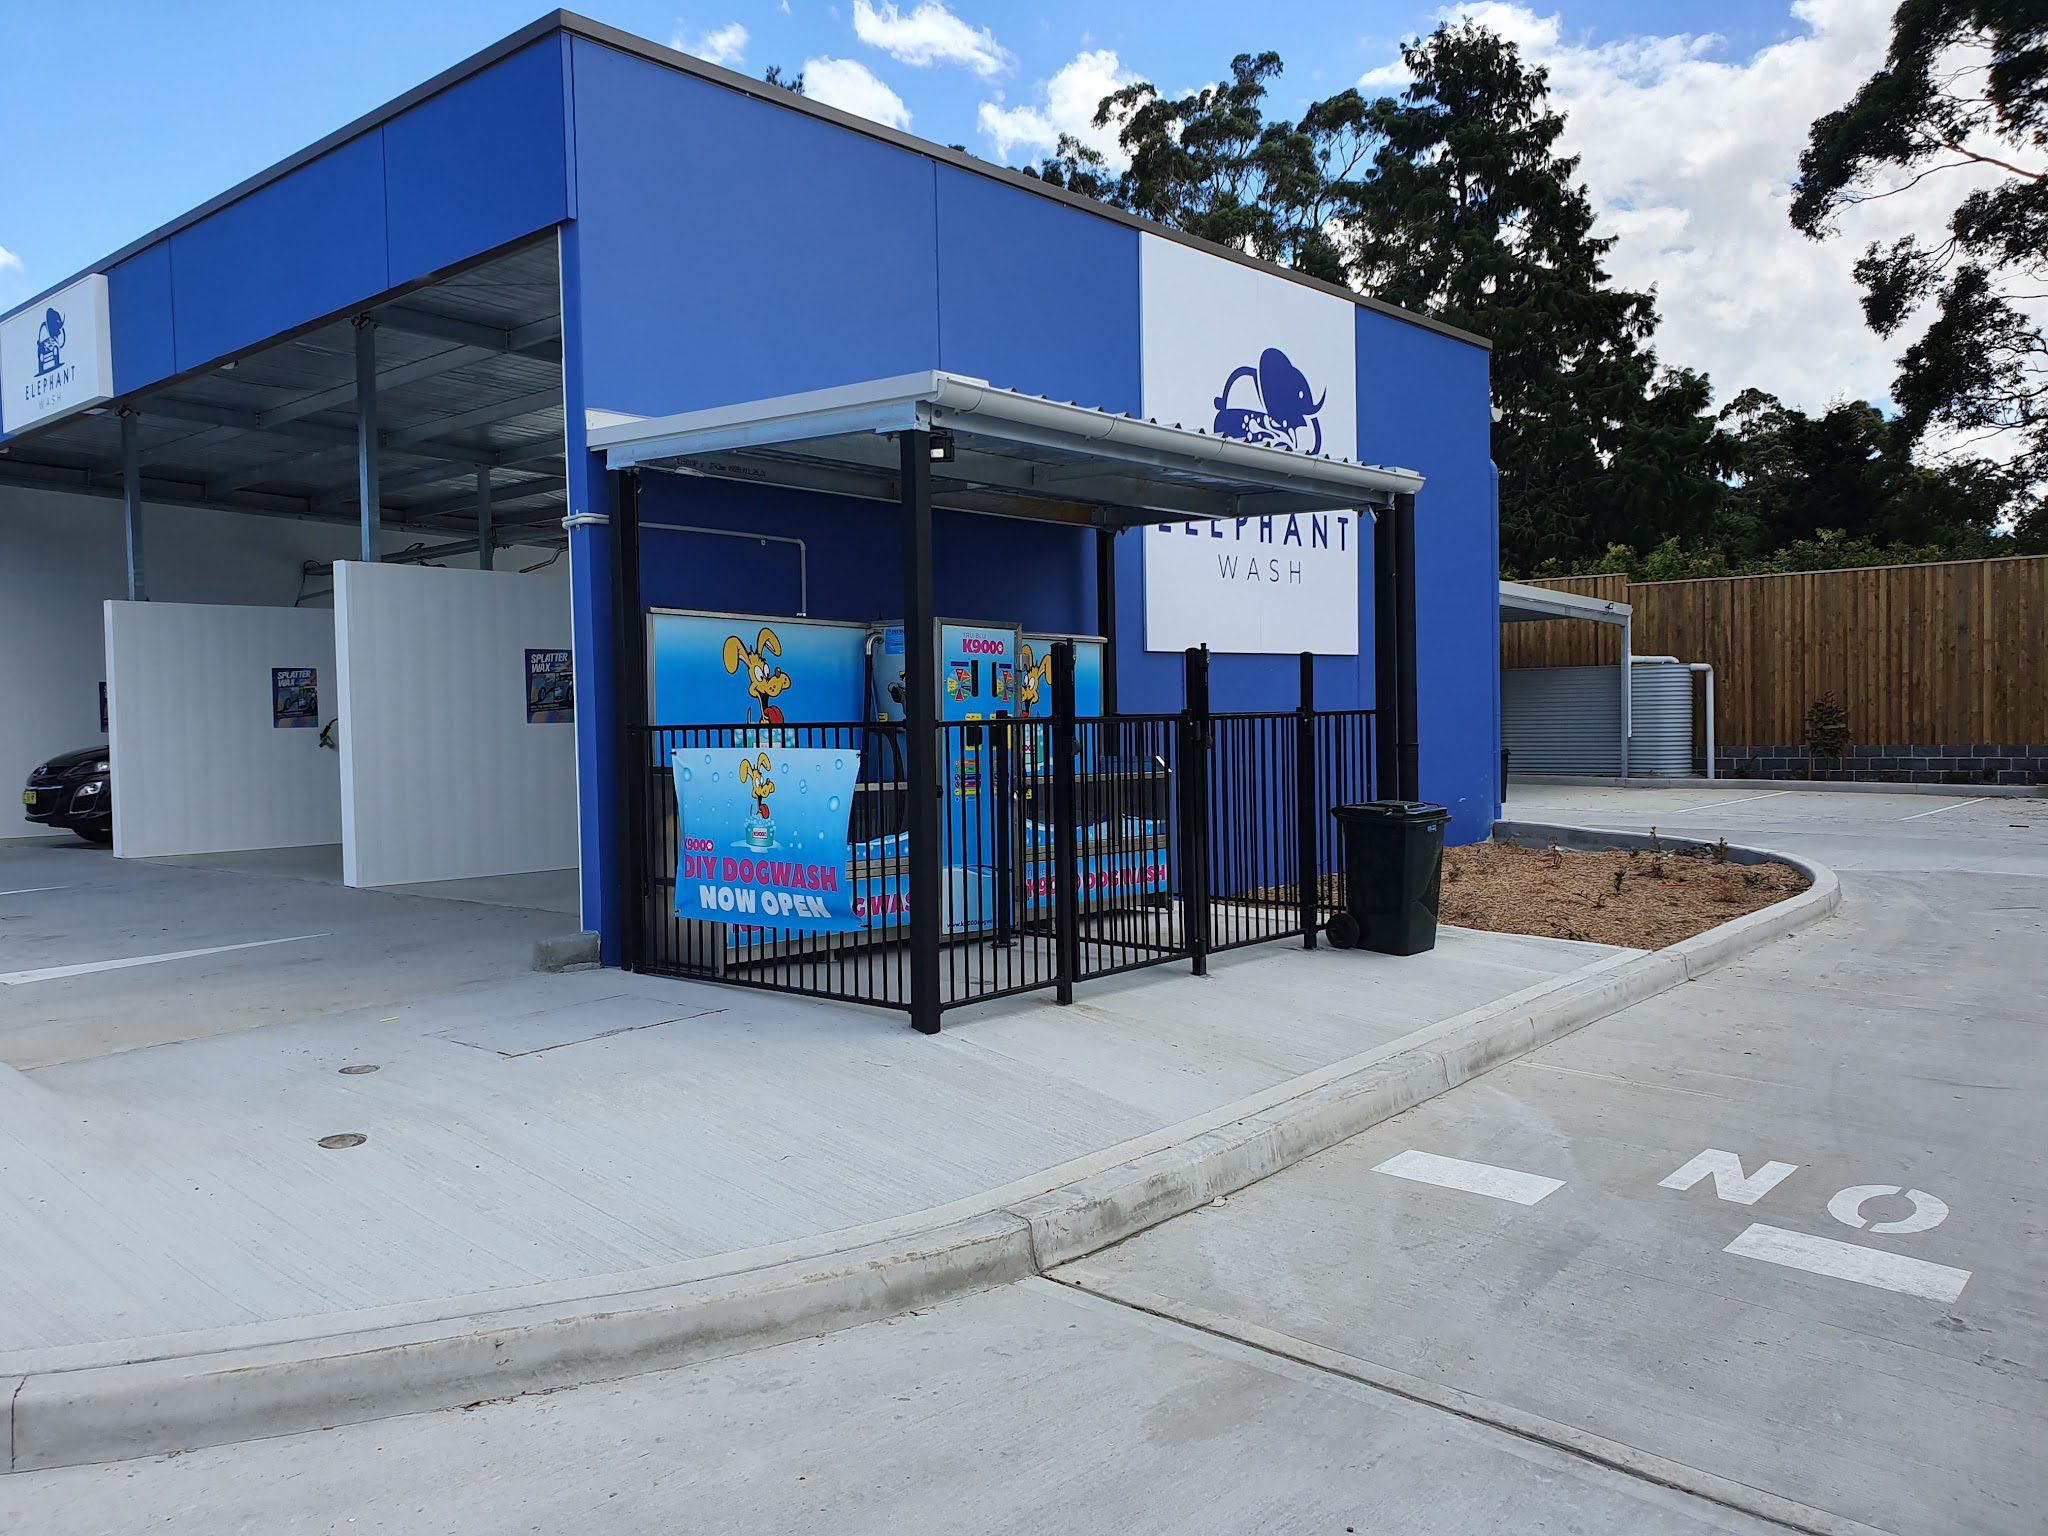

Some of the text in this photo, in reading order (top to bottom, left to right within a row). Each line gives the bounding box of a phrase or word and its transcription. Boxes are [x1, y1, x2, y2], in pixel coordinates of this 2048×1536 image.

[25, 365, 75, 401] ELEPHANT
[1218, 554, 1302, 584] WASH
[531, 652, 568, 664] SPLATTER
[962, 639, 1004, 655] K9000
[277, 670, 312, 680] SPLATTER
[531, 663, 551, 673] WAX
[278, 679, 296, 687] WAX
[684, 854, 838, 892] DIY DOGWASH
[699, 885, 756, 914] NOW
[760, 891, 832, 918] OPEN
[1657, 1148, 1950, 1234] NO
